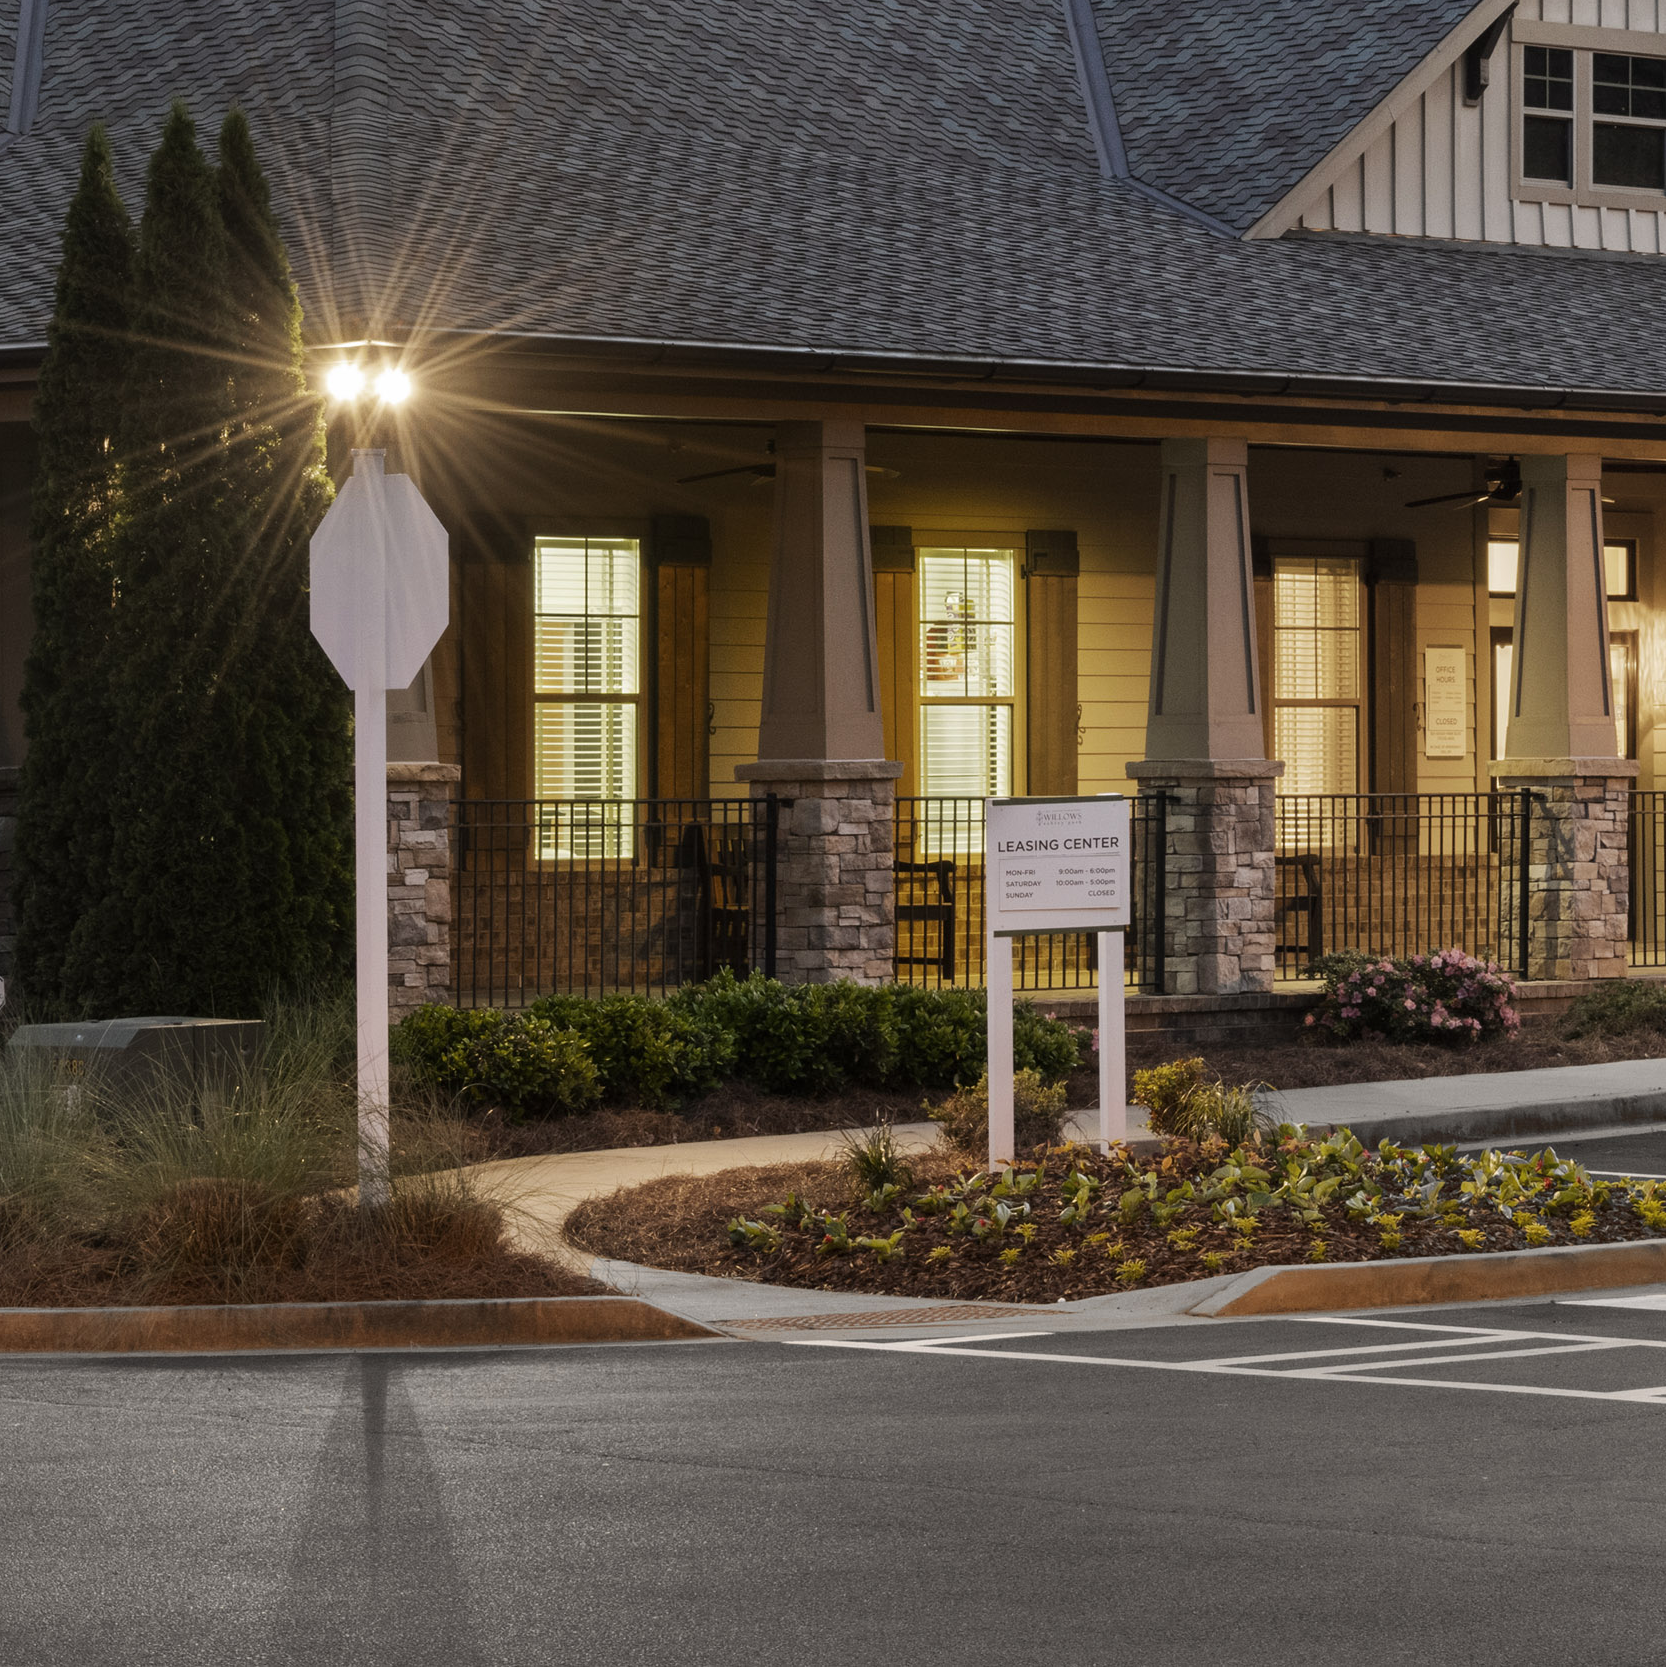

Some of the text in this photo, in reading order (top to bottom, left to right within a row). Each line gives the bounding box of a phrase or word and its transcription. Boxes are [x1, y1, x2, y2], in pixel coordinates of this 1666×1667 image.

[1436, 666, 1455, 674] OFFICE
[1044, 813, 1082, 821] WILLOWS
[998, 837, 1119, 852] LEASING CENTER
